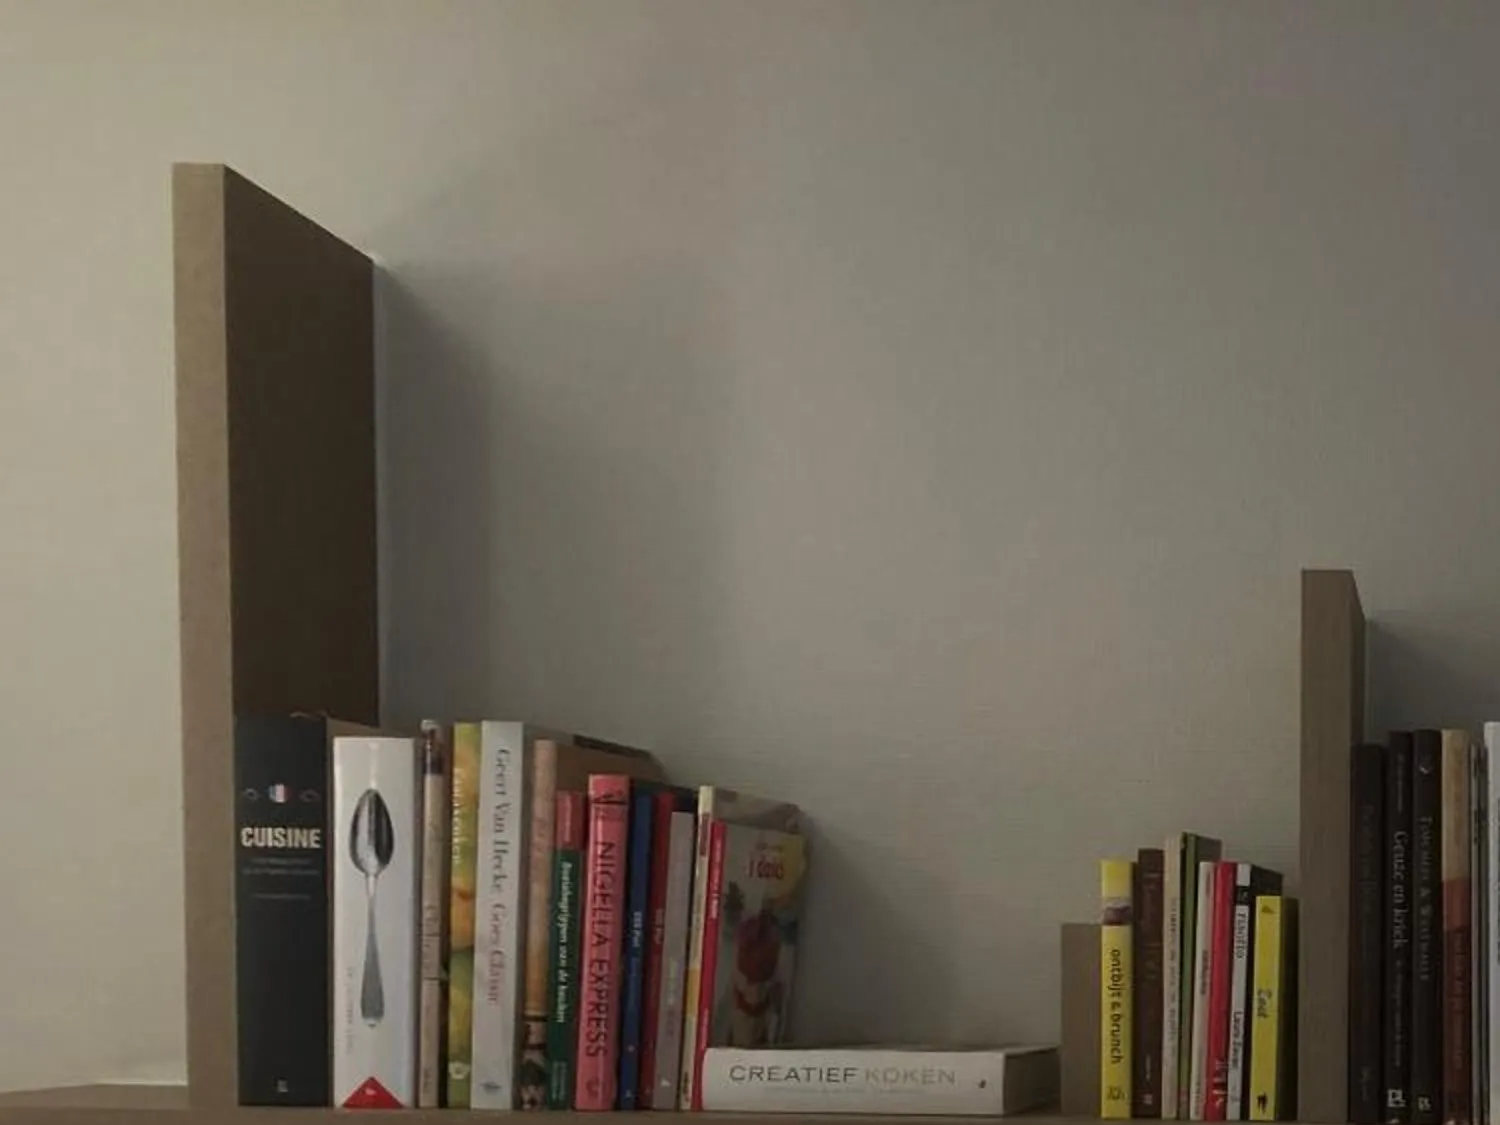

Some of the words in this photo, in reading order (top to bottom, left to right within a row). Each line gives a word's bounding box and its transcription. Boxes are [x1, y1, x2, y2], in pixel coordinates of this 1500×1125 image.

[495, 748, 512, 797] Geert
[241, 826, 321, 848] CUISINE
[493, 802, 511, 834] Van
[491, 838, 510, 892] Hecke
[591, 841, 616, 947] NIGELLA
[1393, 885, 1406, 903] en
[1106, 948, 1123, 998] ontbijt
[586, 958, 610, 1058] EXPRESS
[1109, 1013, 1123, 1064] brunch
[729, 1065, 857, 1083] CREATIEF
[864, 1067, 956, 1085] KOKEN
